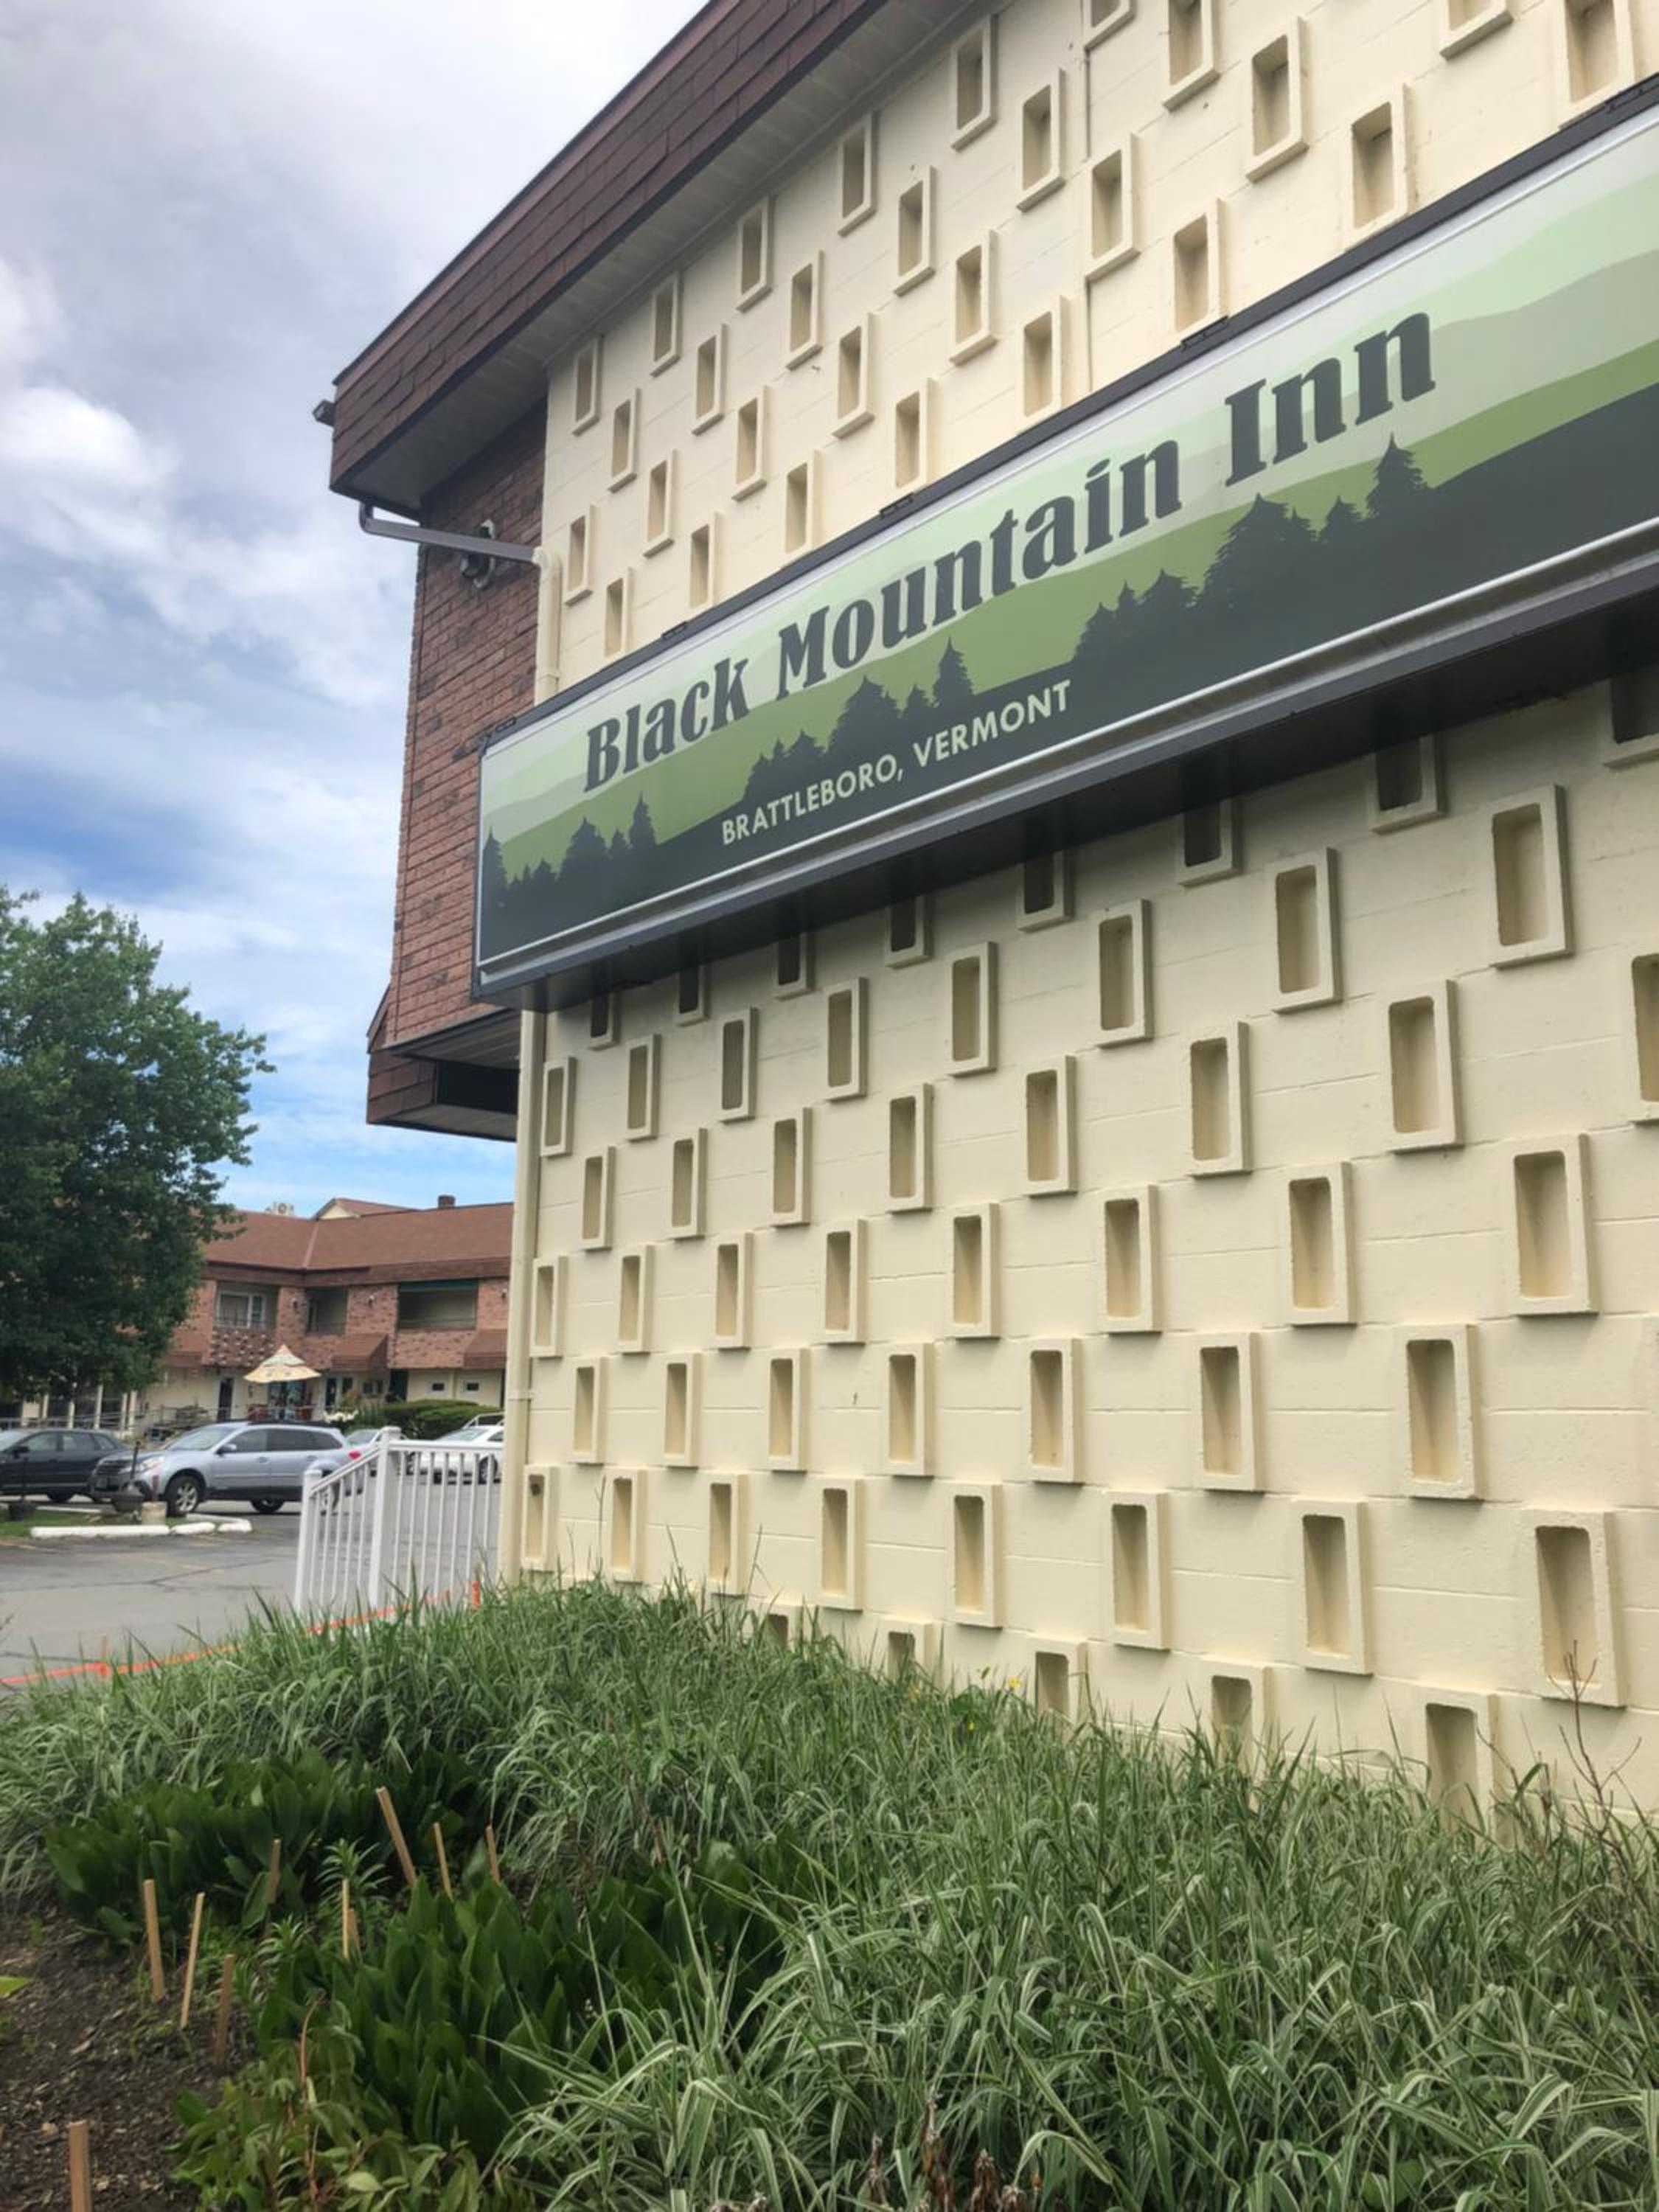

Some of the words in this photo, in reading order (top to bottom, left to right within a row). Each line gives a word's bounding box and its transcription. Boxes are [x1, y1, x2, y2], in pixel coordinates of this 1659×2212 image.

[583, 656, 750, 793] Black
[775, 439, 1183, 701] Mountain
[1224, 311, 1436, 487] Inn
[721, 755, 904, 846] BRATTLEBORO,
[912, 679, 1071, 768] VERMONT
